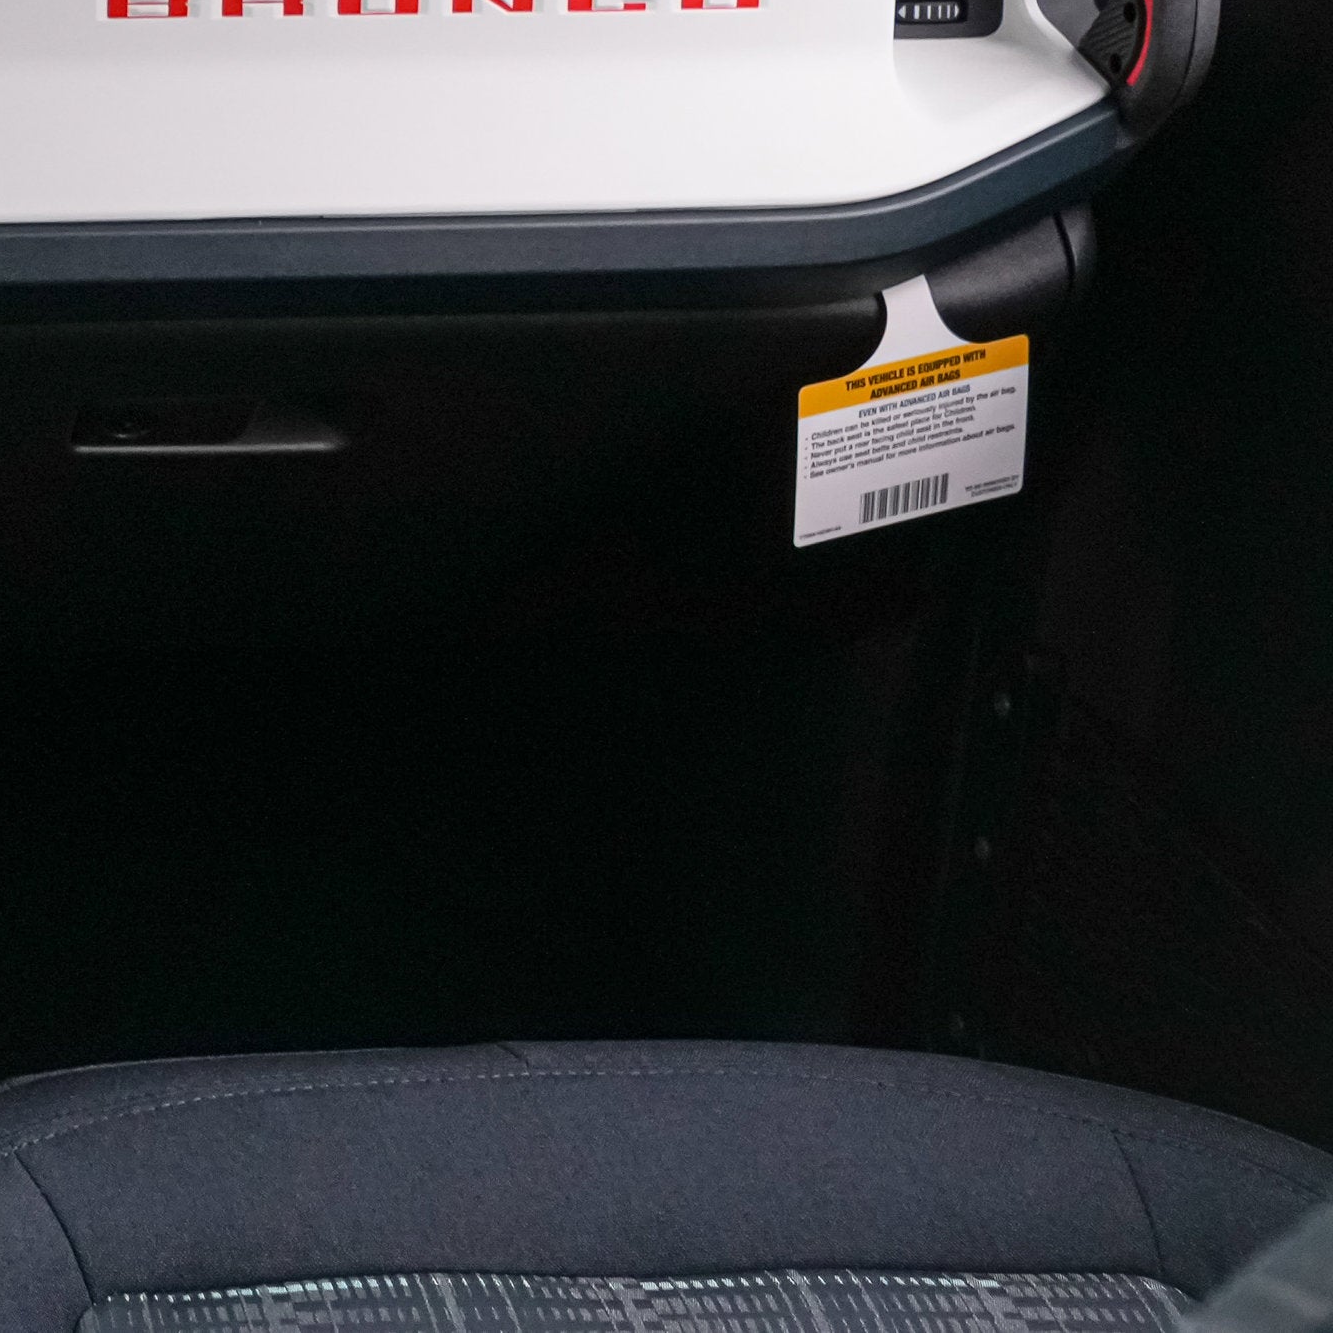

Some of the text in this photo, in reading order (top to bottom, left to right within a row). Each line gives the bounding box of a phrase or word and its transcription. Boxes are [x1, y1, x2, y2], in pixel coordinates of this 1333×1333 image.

[845, 348, 987, 392] THIS VEHICLE IS EQUIPPED WITH
[870, 369, 961, 400] ADVANCED AIR BAGS
[858, 384, 971, 419] EVEN WITH ADVANCED AIR BAGS
